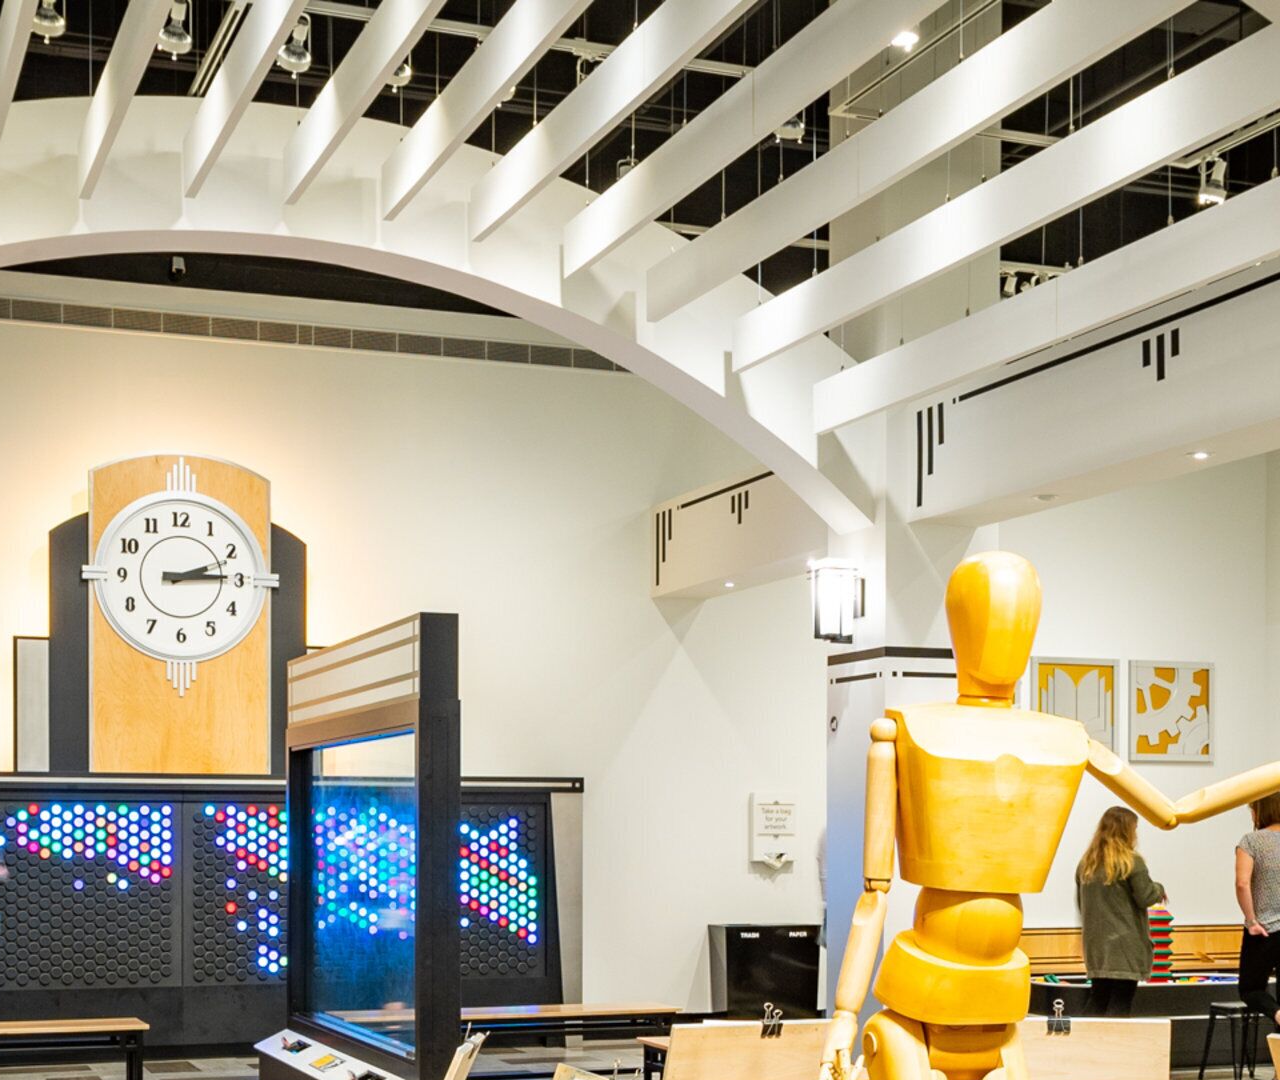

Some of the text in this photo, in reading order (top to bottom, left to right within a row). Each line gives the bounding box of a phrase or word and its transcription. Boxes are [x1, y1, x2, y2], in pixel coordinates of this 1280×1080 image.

[144, 517, 159, 534] 11
[172, 511, 191, 528] 12
[207, 521, 214, 537] 1
[120, 538, 139, 554] 10
[226, 543, 237, 559] 2
[117, 567, 128, 583] 9
[234, 572, 245, 588] 3
[125, 596, 136, 612] 8
[225, 601, 237, 616] 4
[146, 618, 158, 634] 7
[205, 620, 216, 637] 5
[176, 627, 187, 643] 6
